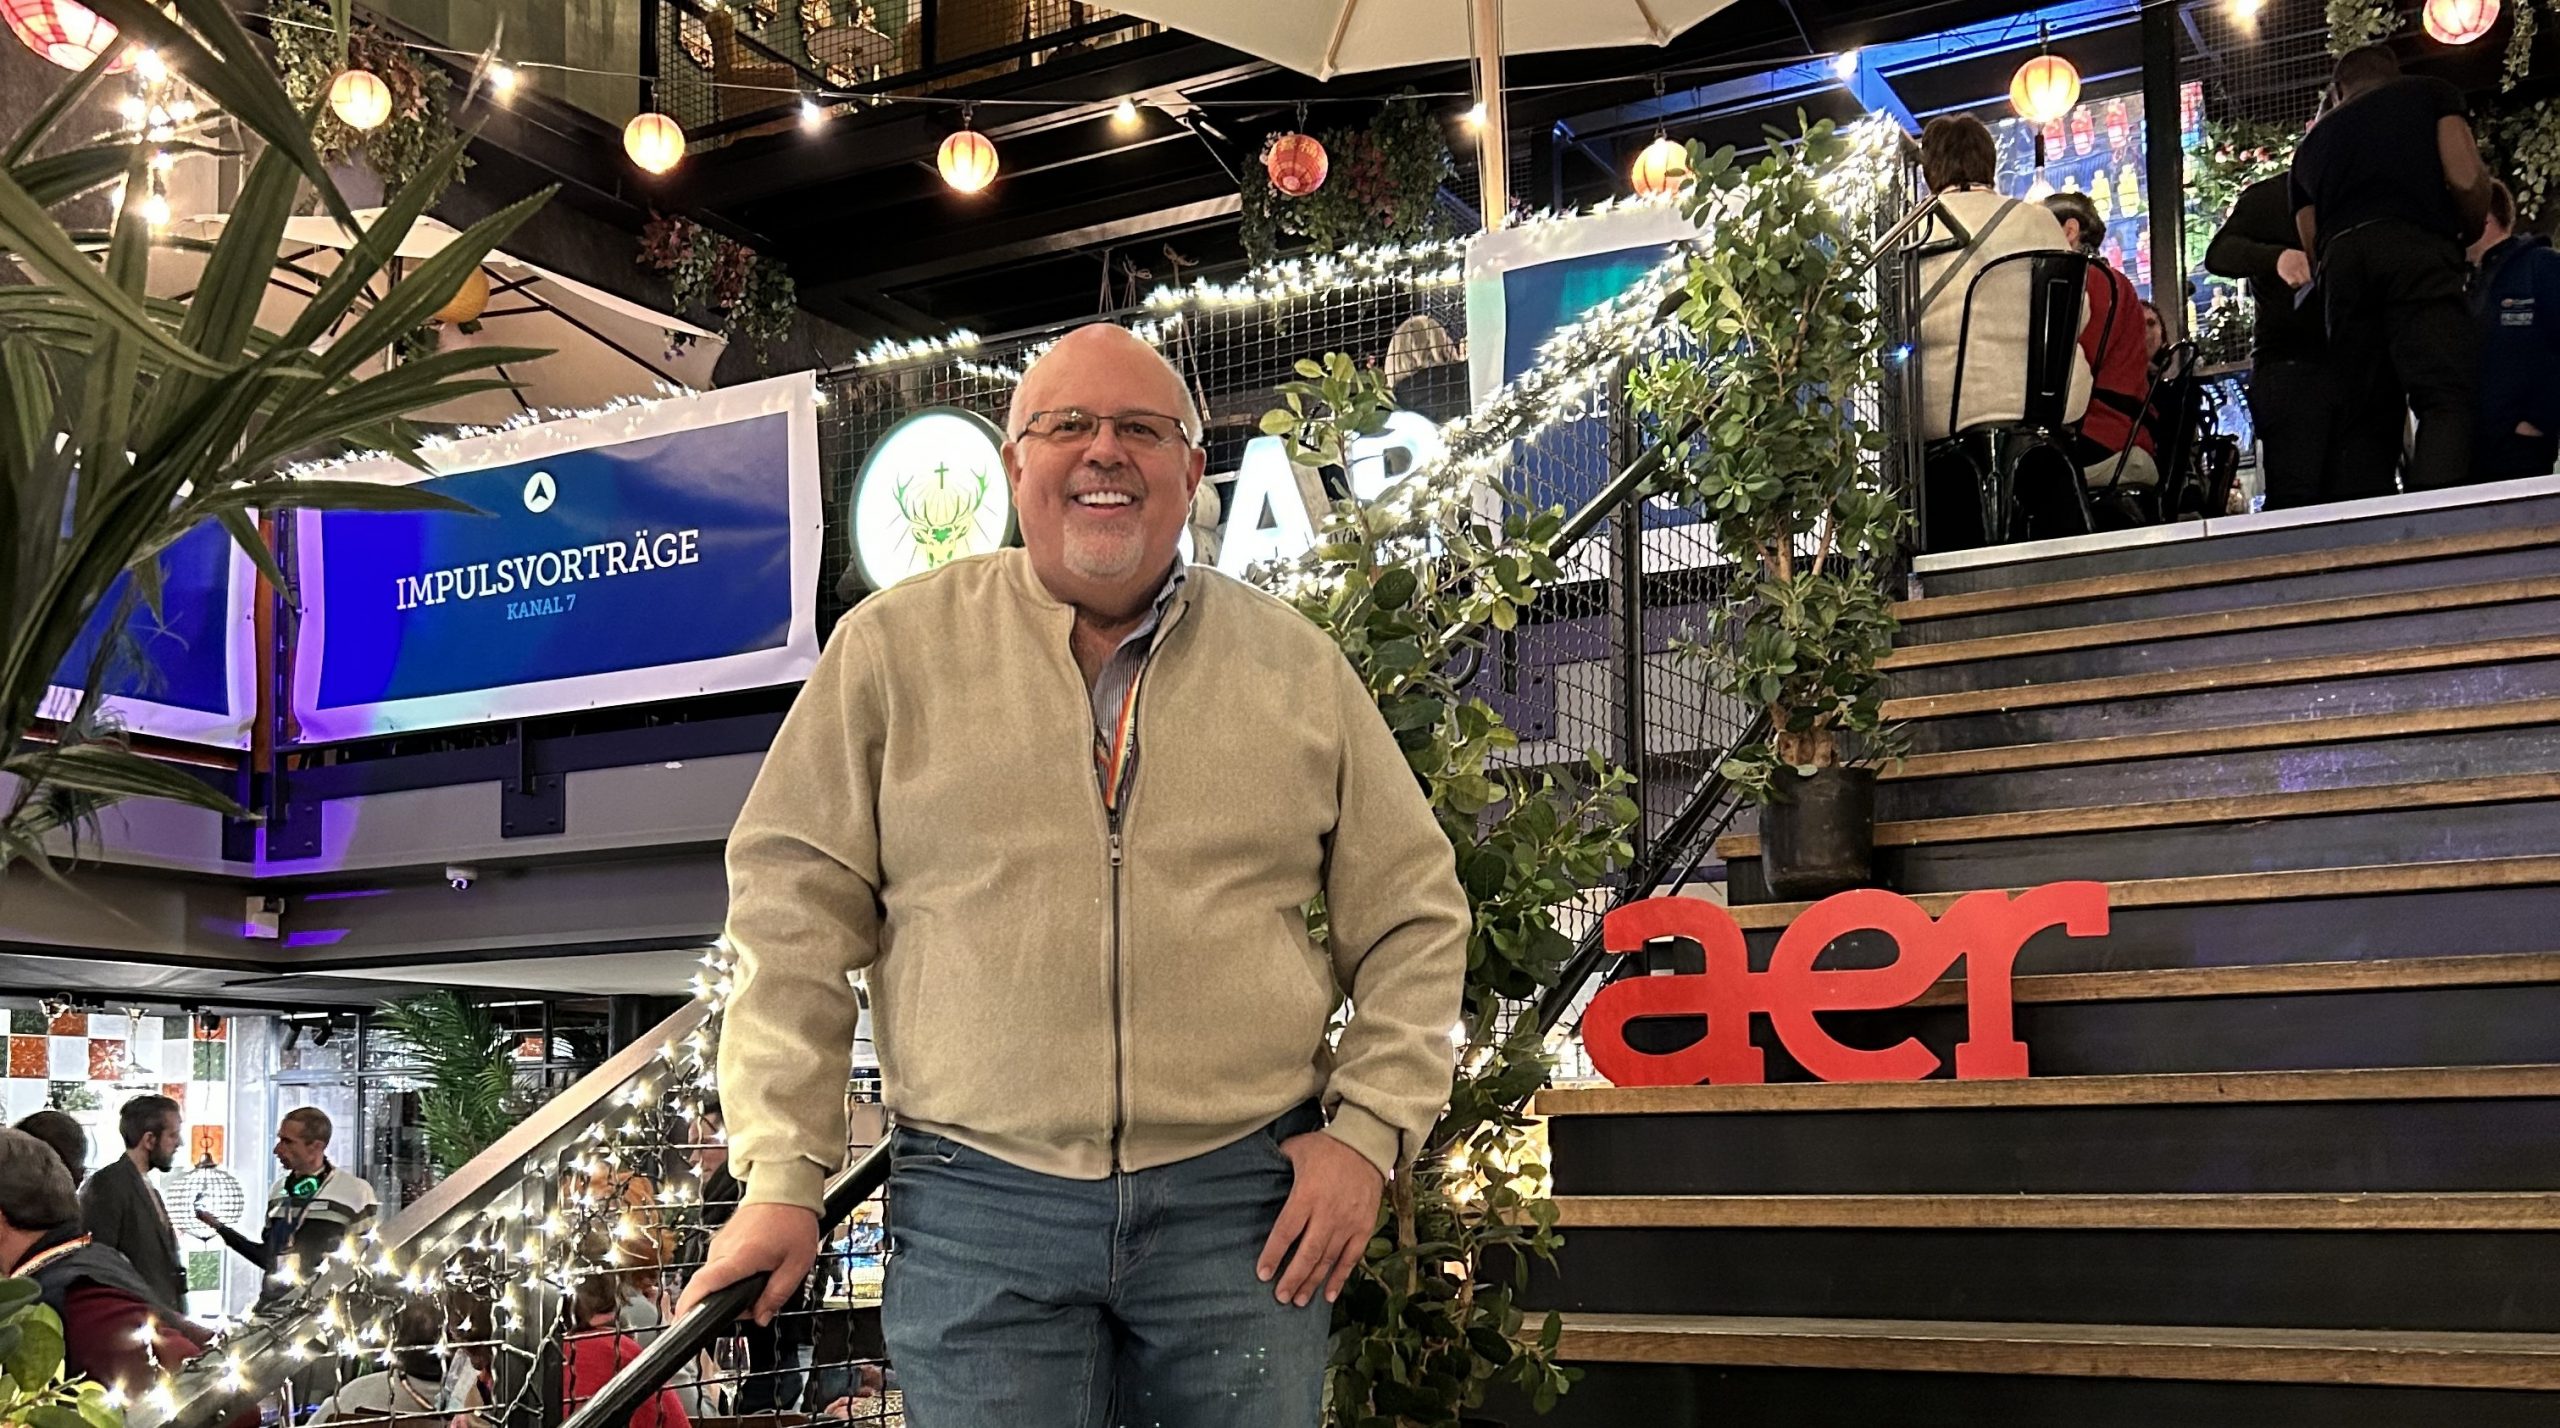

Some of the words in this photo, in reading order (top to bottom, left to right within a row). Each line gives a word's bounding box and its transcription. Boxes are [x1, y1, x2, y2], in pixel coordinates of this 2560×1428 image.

[396, 529, 700, 610] IMPULSVORTRÄGE
[506, 596, 564, 620] KANAL
[565, 594, 577, 612] 7
[1582, 880, 2110, 1087] aer
